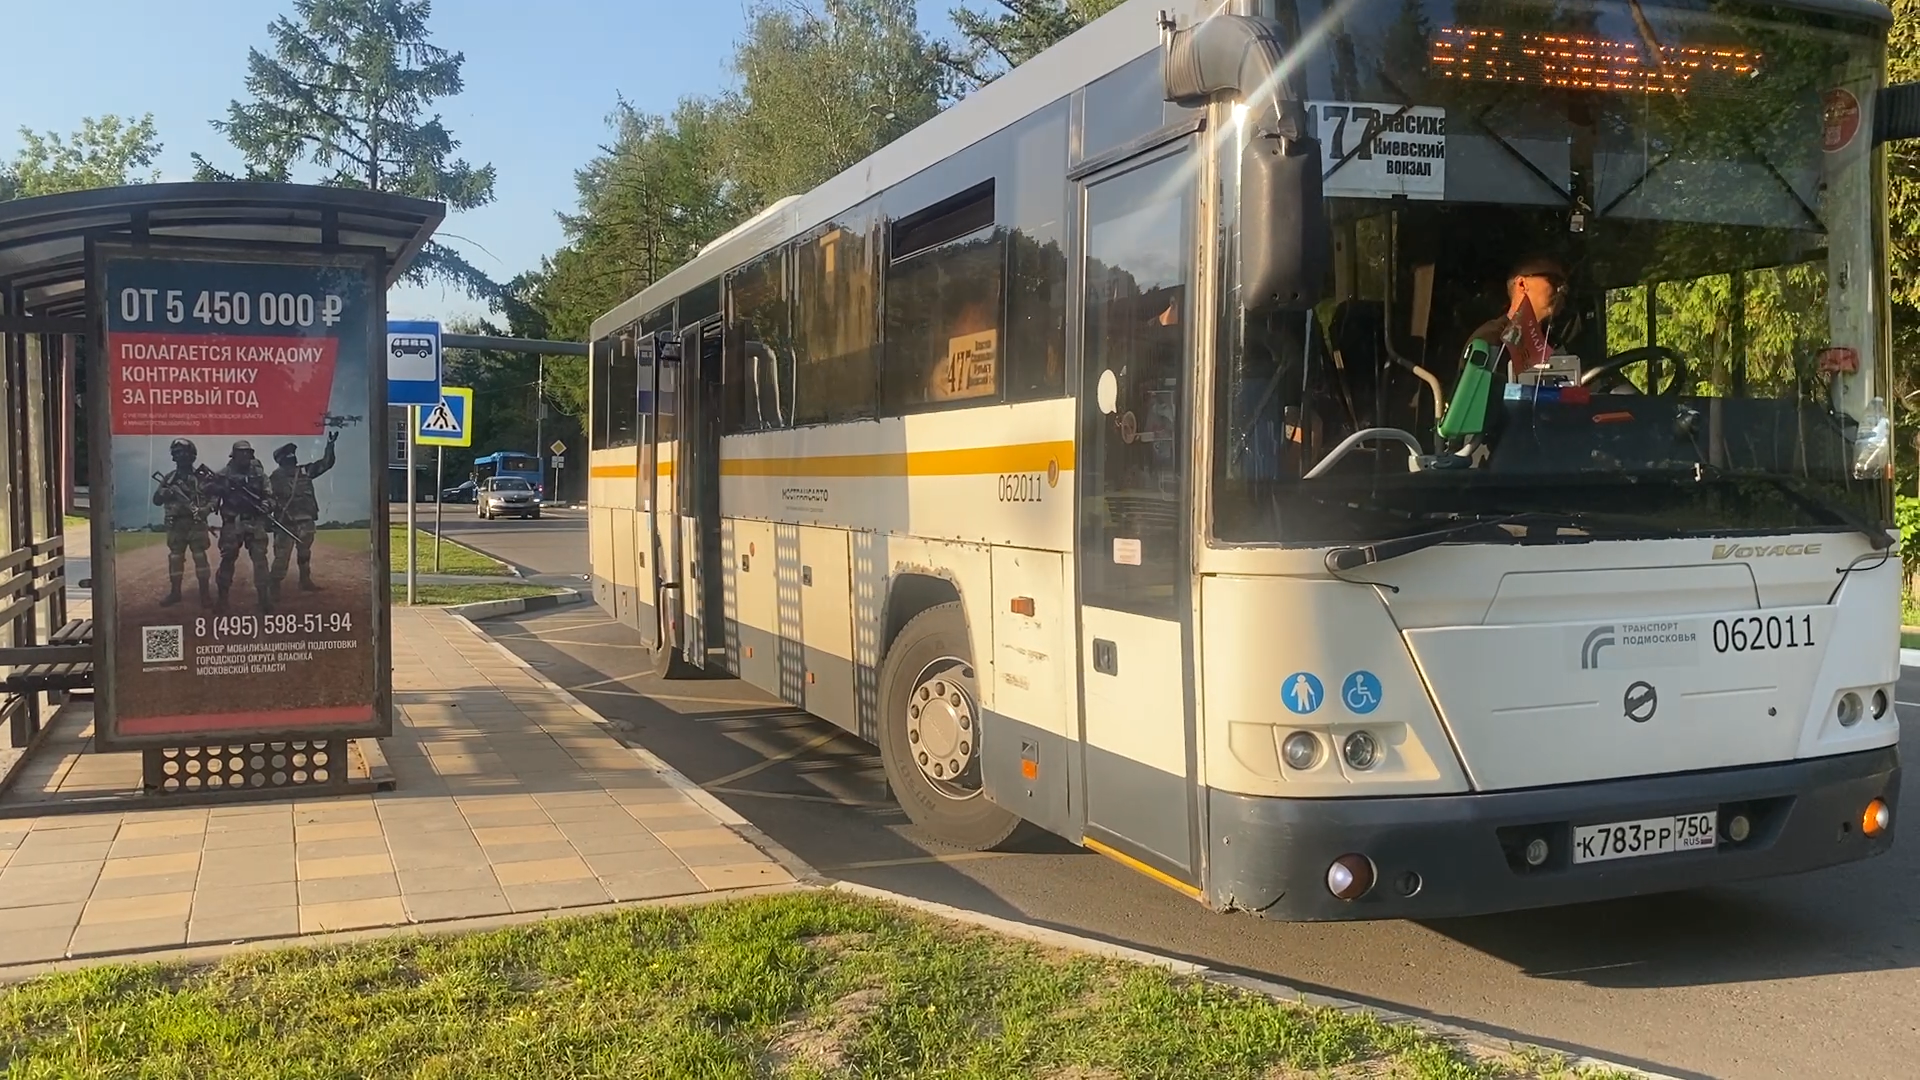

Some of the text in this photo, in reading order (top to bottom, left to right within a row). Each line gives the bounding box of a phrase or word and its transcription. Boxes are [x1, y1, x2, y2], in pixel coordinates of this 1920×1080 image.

[1374, 138, 1445, 159] Киевский
[120, 288, 157, 322] ОТ
[166, 290, 185, 324] 5
[193, 291, 250, 325] 450
[259, 293, 314, 327] 000
[121, 343, 323, 365] ПОЛАГАЕТСЯ КАЖДОМУ
[121, 366, 258, 384] КОНТРАКТНИКУ
[122, 386, 259, 408] ЗА ПЕРВЫЙ ГОД
[998, 474, 1042, 502] 062011
[194, 612, 352, 640] 8 (495) 598-51-94
[1622, 622, 1678, 633] ТРАНСПОРТ
[1713, 614, 1815, 653] 062011
[196, 640, 358, 655] СЕКТОР МОБИЛИЗАЦИОННОЙ ПОДГОТОВКИ
[1622, 633, 1696, 645] ПОДМОСКОВЬЯ
[196, 652, 313, 665] ГОРОДСКОГО ОКРУГА ВЛАСИХА
[196, 664, 249, 676] МОСКОВСКОЙ
[251, 663, 286, 673] ОБЛАСТИ
[1676, 816, 1710, 839] 750
[1683, 838, 1700, 846] RUS
